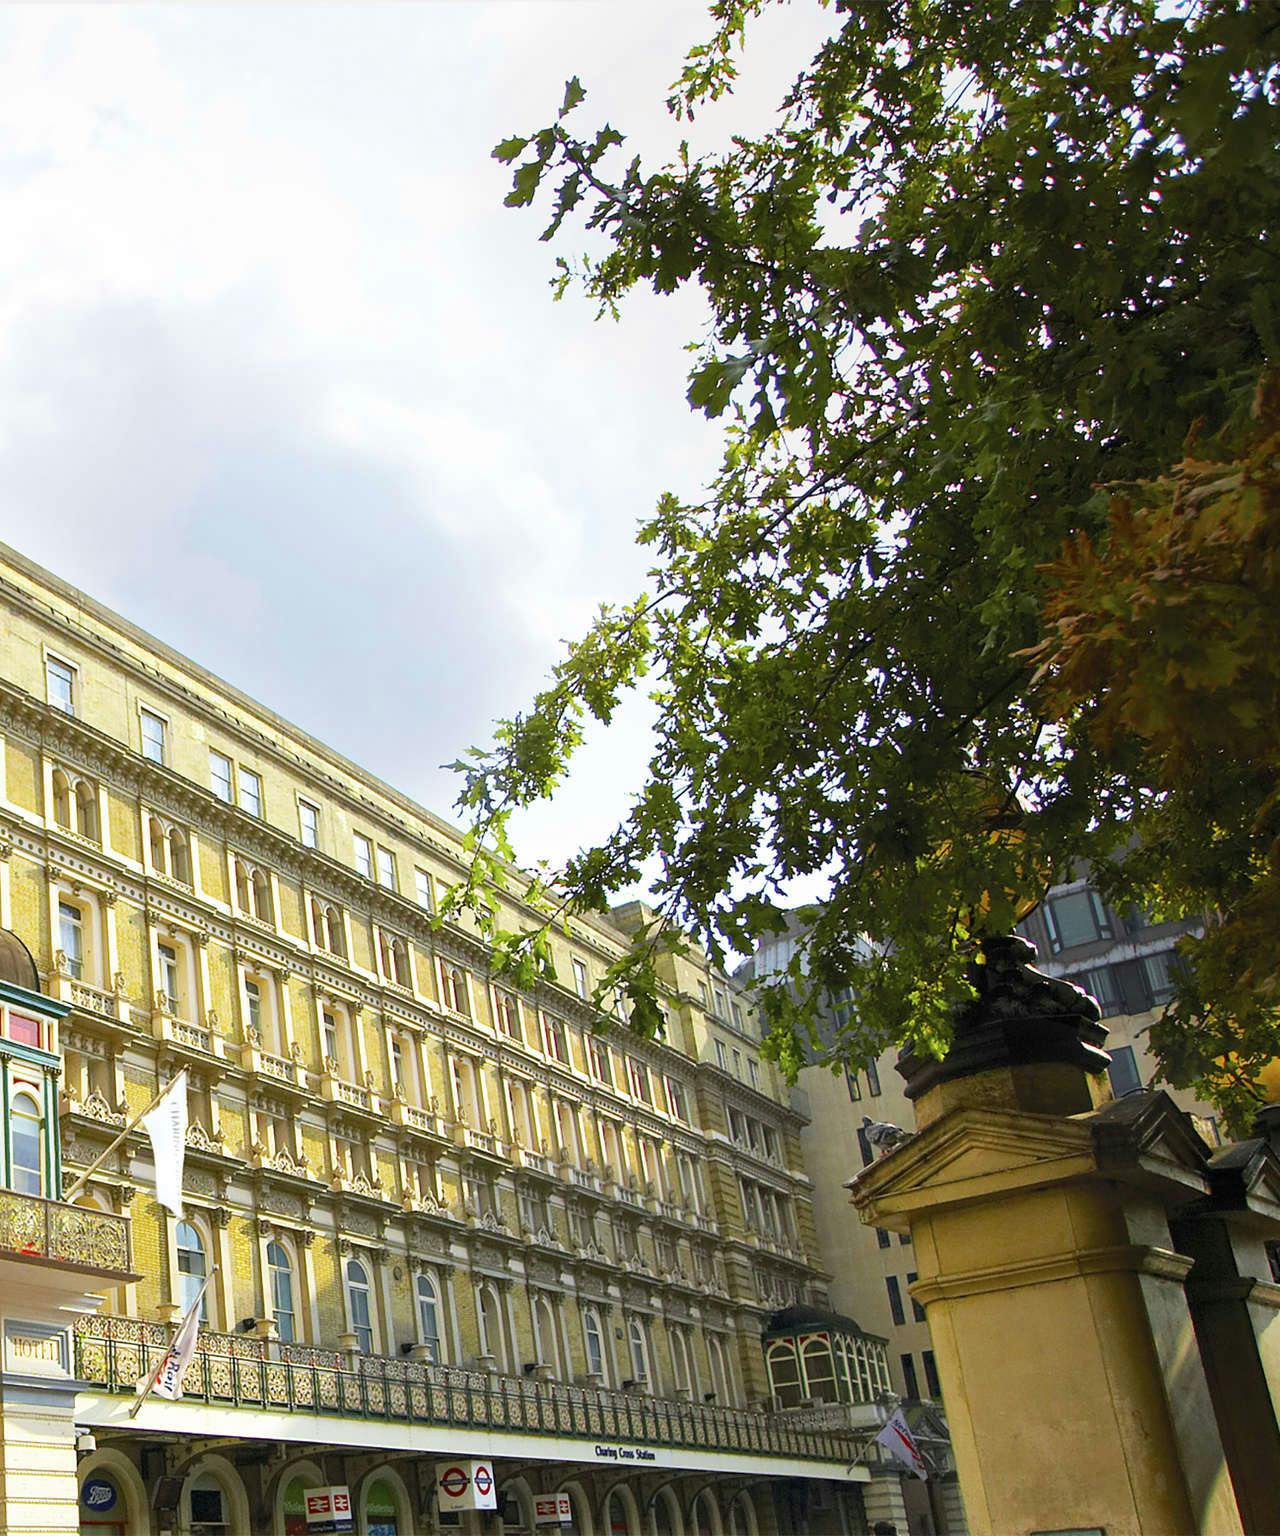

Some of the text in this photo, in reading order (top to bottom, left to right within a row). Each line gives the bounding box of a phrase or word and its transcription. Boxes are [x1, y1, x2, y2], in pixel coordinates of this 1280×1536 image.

[13, 1337, 59, 1361] HOTEL
[595, 1445, 656, 1460] Charing Cross Station
[86, 1485, 113, 1505] Boots
